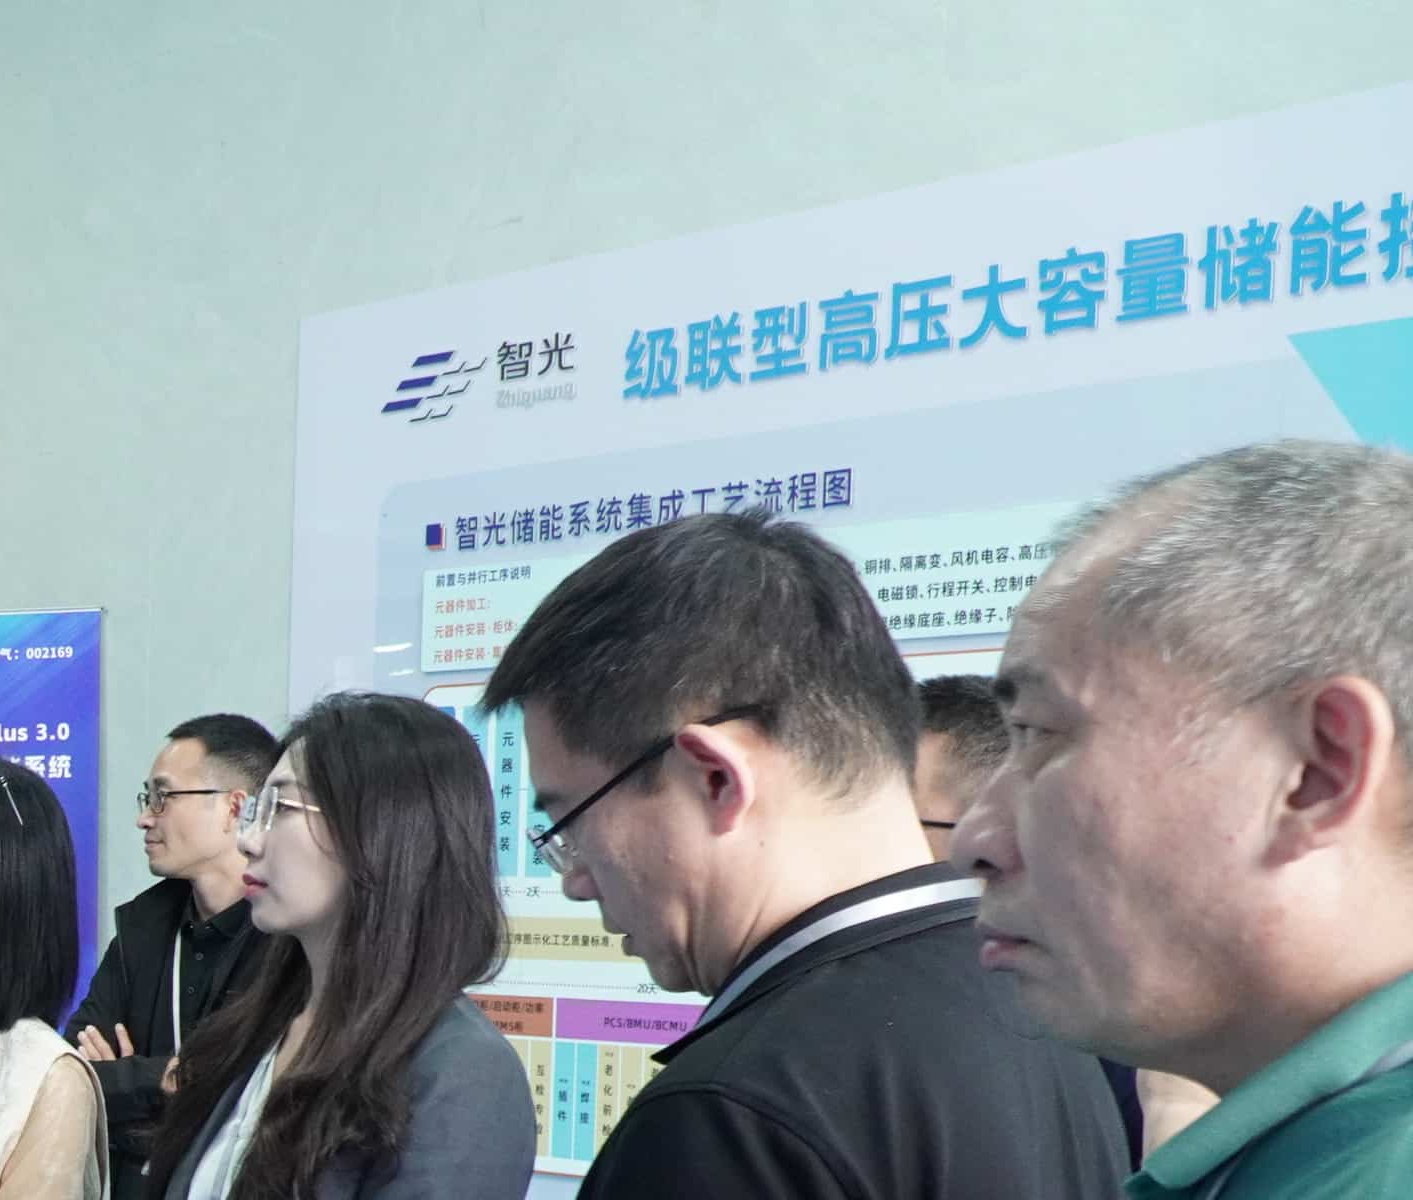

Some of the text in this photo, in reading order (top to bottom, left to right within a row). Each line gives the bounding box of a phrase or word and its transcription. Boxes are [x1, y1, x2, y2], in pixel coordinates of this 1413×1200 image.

[496, 331, 575, 381] 智光
[455, 468, 853, 551] 智光储能系统集成工艺流程图
[435, 565, 532, 588] 前置与并行工序说明
[26, 646, 73, 660] 002169
[36, 723, 70, 741] 3.0
[604, 1017, 687, 1032] PCS/BMU/BCMU
